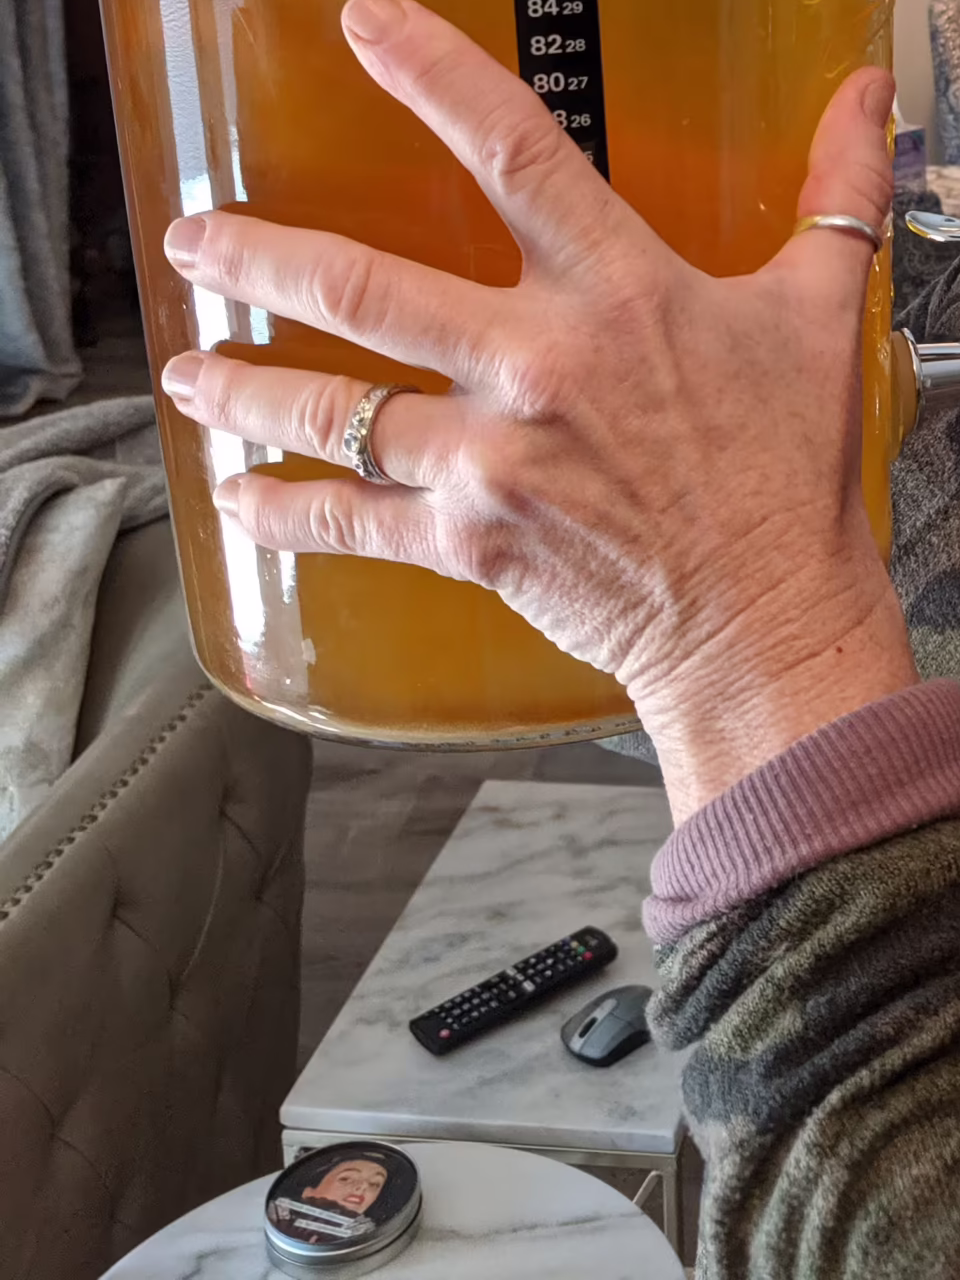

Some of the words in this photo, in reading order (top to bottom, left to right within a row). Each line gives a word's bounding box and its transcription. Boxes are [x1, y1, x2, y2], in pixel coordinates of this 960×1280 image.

[562, 1, 583, 15] 29
[530, 34, 563, 56] 82
[565, 38, 586, 53] 28
[533, 72, 565, 95] 80
[567, 76, 588, 91] 27
[551, 109, 568, 129] 8
[570, 113, 592, 128] 26
